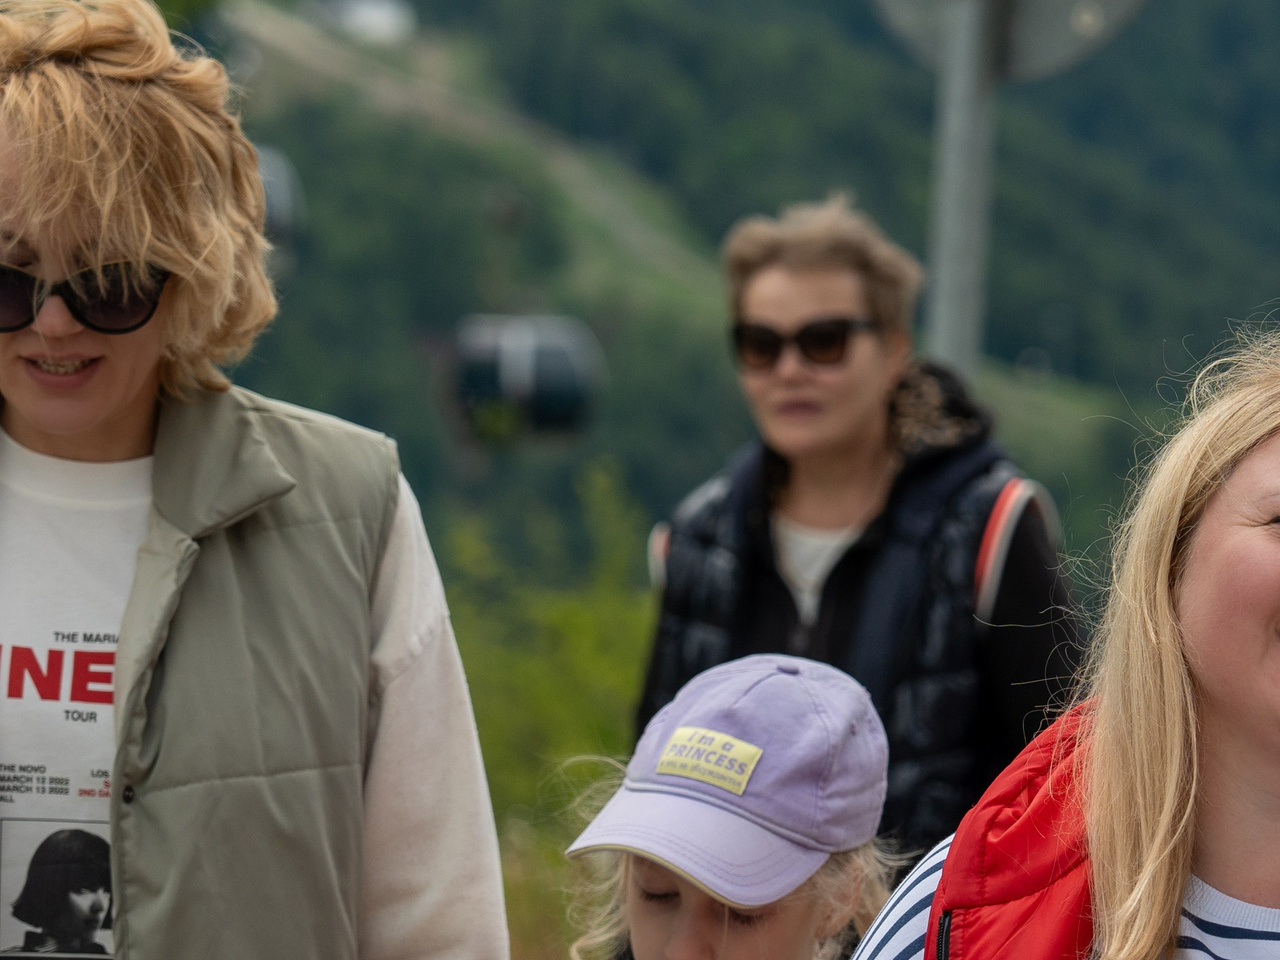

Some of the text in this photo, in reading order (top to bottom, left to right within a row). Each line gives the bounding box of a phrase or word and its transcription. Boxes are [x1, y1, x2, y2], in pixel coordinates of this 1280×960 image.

[53, 631, 79, 644] THE
[0, 645, 115, 705] NE
[64, 710, 97, 723] TOUR
[666, 743, 748, 776] PRINCESS
